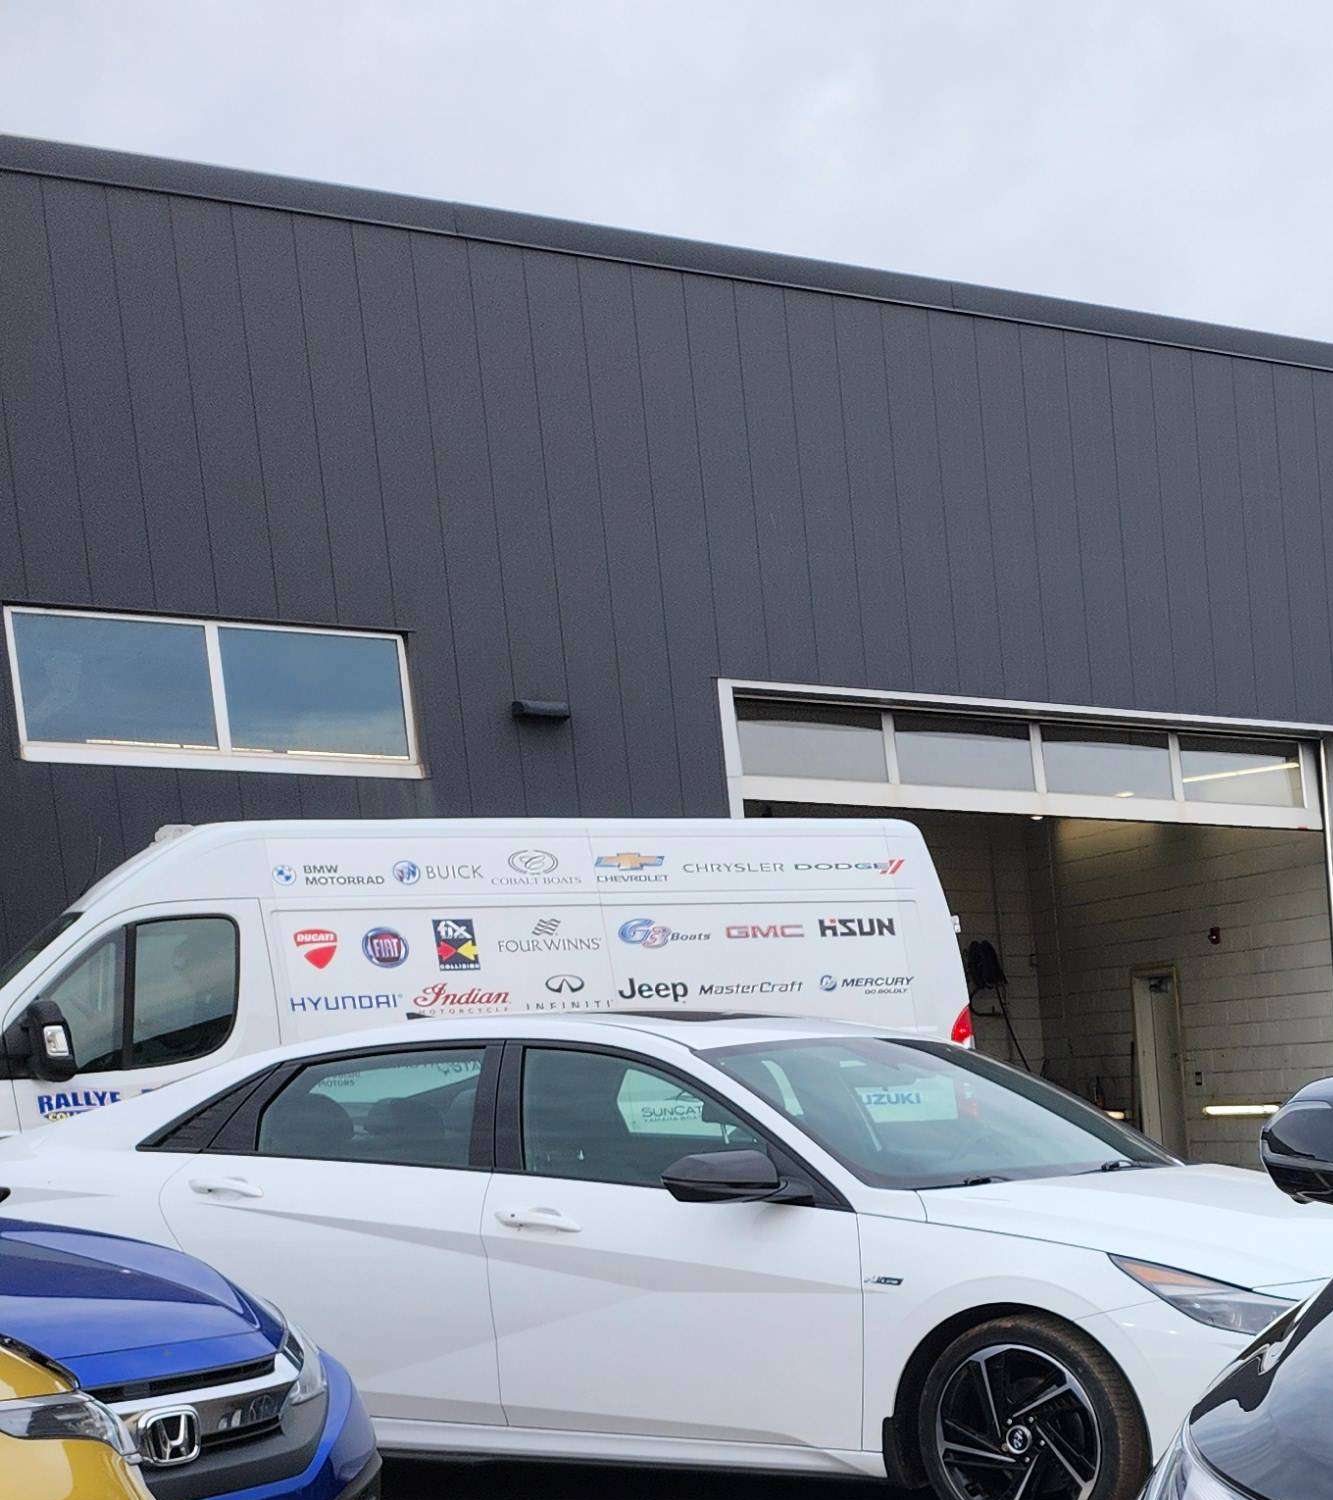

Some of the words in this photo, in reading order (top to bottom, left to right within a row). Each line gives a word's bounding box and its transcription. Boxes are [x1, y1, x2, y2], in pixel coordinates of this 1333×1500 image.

[303, 865, 338, 874] BMW
[426, 864, 484, 880] BUICK
[683, 863, 784, 873] CHRYSLER
[794, 862, 888, 871] DODGE
[305, 875, 385, 886] MOTORRAD
[491, 876, 540, 886] COBALT
[543, 875, 582, 885] BOATS
[597, 875, 669, 883] CHEVROLET
[296, 934, 334, 942] DUCATI
[670, 932, 710, 941] Boats
[726, 925, 804, 939] GMC
[373, 938, 399, 958] FIAT
[498, 938, 541, 953] FOUR
[542, 938, 600, 951] WINNS
[841, 976, 914, 988] MERCURY
[619, 978, 688, 1001] Jeep
[700, 981, 803, 996] MasterCraft
[413, 983, 509, 1007] Indian
[290, 994, 398, 1012] HYUNDAI
[526, 1000, 611, 1011] INFINITI
[37, 1091, 121, 1114] RALLYE
